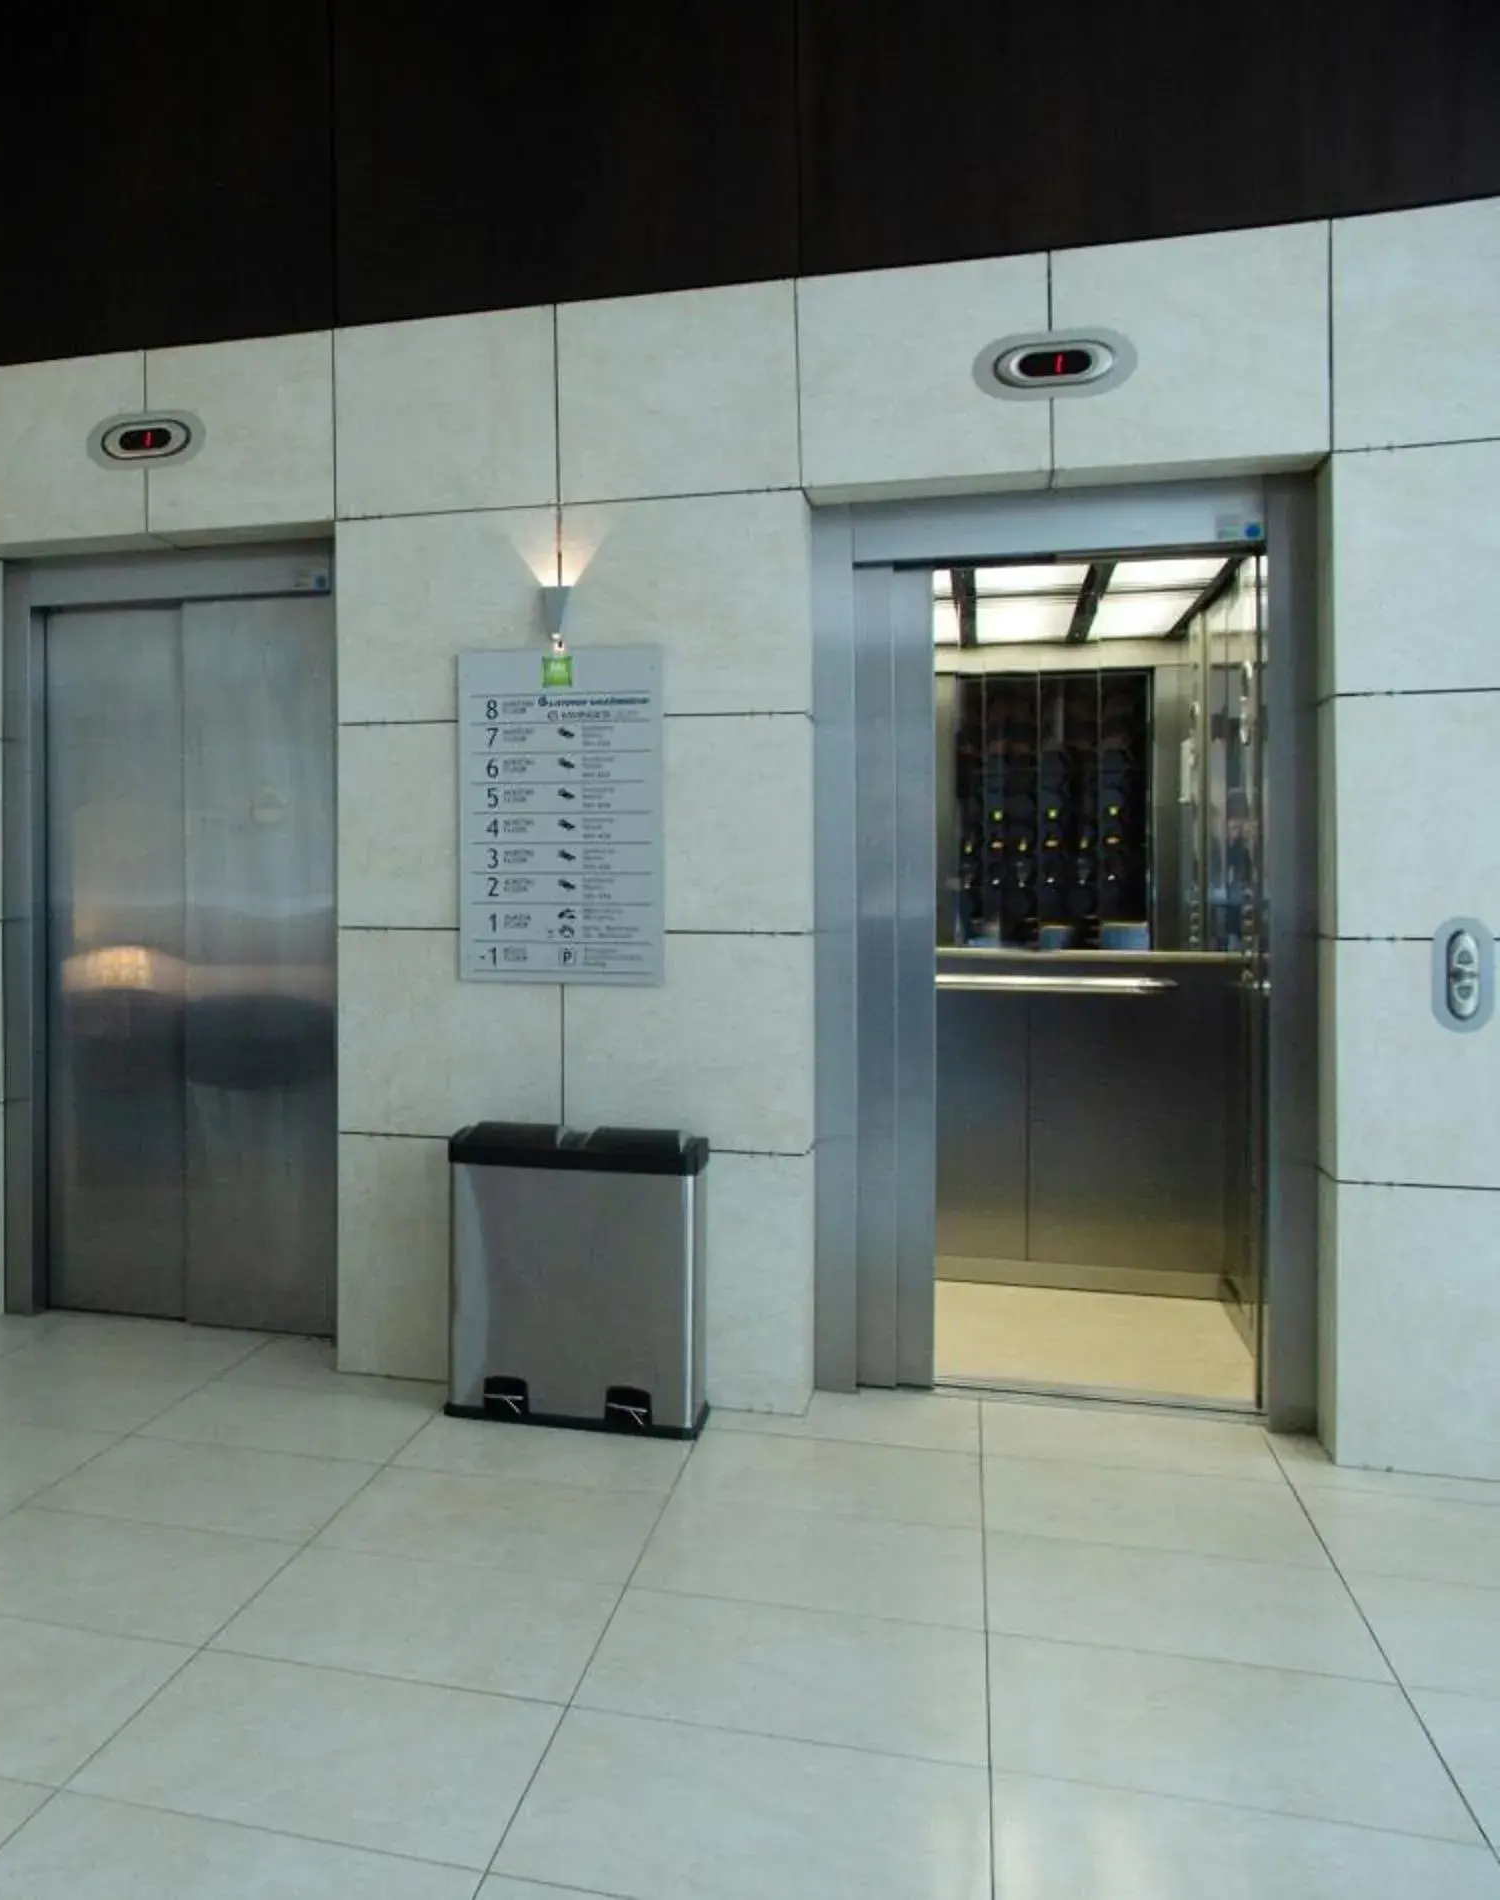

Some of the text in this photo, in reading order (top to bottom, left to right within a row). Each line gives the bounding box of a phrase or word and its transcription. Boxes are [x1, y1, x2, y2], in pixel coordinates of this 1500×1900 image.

[486, 700, 498, 720] 8
[487, 726, 499, 747] 7
[486, 759, 498, 778] 6
[487, 788, 499, 808] 5
[486, 819, 498, 837] 4
[488, 848, 498, 869] 3
[488, 877, 499, 897] 2
[489, 913, 497, 932] 1
